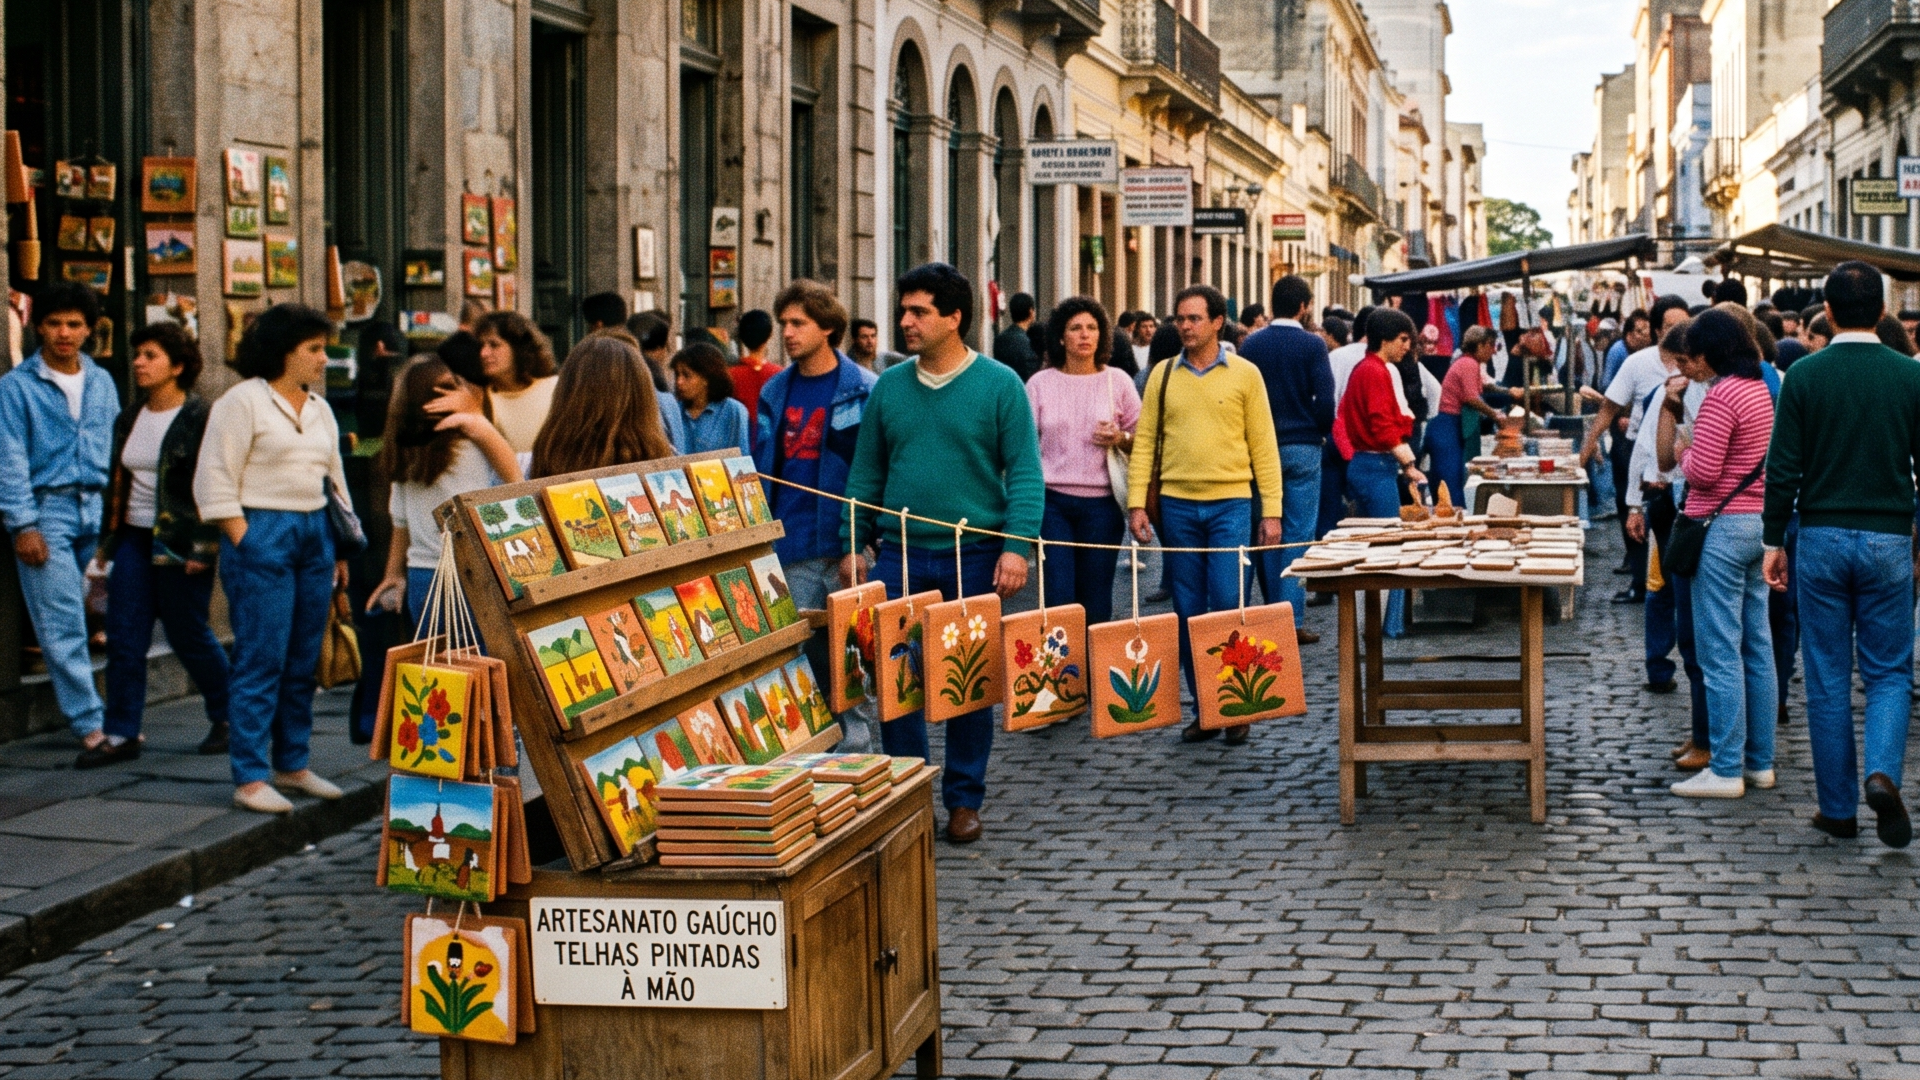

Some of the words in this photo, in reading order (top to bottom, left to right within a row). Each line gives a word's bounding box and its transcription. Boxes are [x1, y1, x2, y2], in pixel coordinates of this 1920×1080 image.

[537, 907, 677, 935] ARTESANATO
[687, 903, 777, 937] GAÚCHO
[554, 940, 639, 967] TELHAS
[652, 942, 760, 969] PINTADAS
[621, 969, 636, 1000] À
[648, 970, 695, 1002] MÃO
